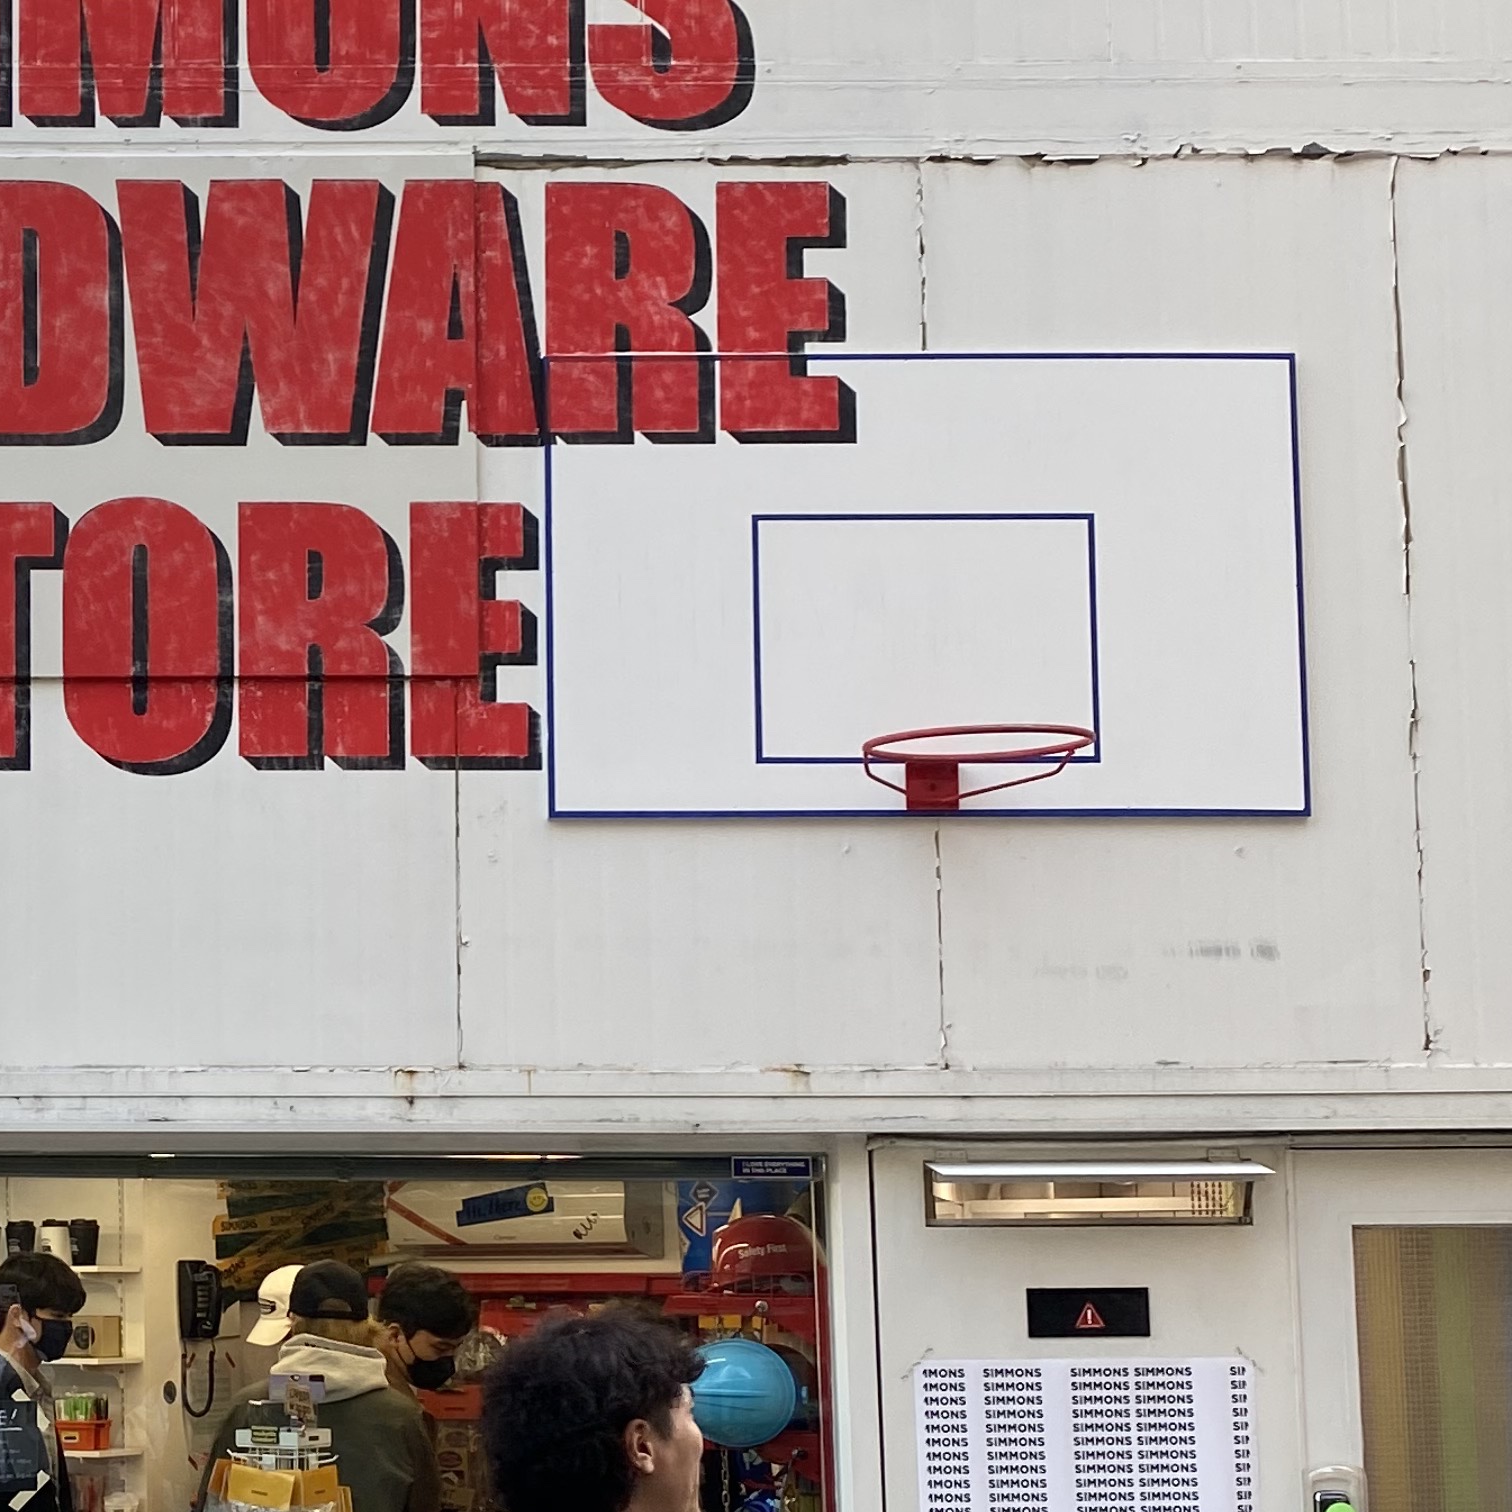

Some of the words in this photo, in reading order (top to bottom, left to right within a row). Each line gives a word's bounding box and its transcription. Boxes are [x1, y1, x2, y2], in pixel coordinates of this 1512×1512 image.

[738, 1246, 765, 1259] Safety
[983, 1368, 1042, 1378] SIMMONS
[1070, 1367, 1129, 1377] SIMMONS
[1134, 1367, 1192, 1377] SIMMONS
[984, 1382, 1042, 1391] SIMMONS
[1071, 1381, 1130, 1391] SIMMONS
[1134, 1381, 1193, 1390] SIMMONS
[984, 1396, 1043, 1405] SIMMONS
[1072, 1395, 1130, 1405] SIMMONS
[1135, 1394, 1193, 1404] SIMMONS
[985, 1409, 1043, 1419] SIMMONS
[1072, 1409, 1130, 1418] SIMMONS
[1135, 1408, 1194, 1418] SIMMONS
[986, 1437, 1045, 1446] SIMMONS
[1073, 1436, 1132, 1446] SIMMONS
[1137, 1436, 1196, 1445] SIMMONS
[987, 1451, 1046, 1460] SIMMONS
[1074, 1450, 1132, 1460] SIMMONS
[1137, 1450, 1196, 1459] SIMMONS
[988, 1465, 1046, 1474] SIMMONS
[1075, 1464, 1133, 1473] SIMMONS
[1138, 1463, 1197, 1473] SIMMONS
[989, 1479, 1047, 1488] SIMMONS
[1076, 1478, 1134, 1488] SIMMONS
[1139, 1478, 1198, 1487] SIMMONS
[989, 1493, 1048, 1502] SIMMONS
[1076, 1492, 1135, 1501] SIMMONS
[1140, 1491, 1199, 1501] SIMMONS
